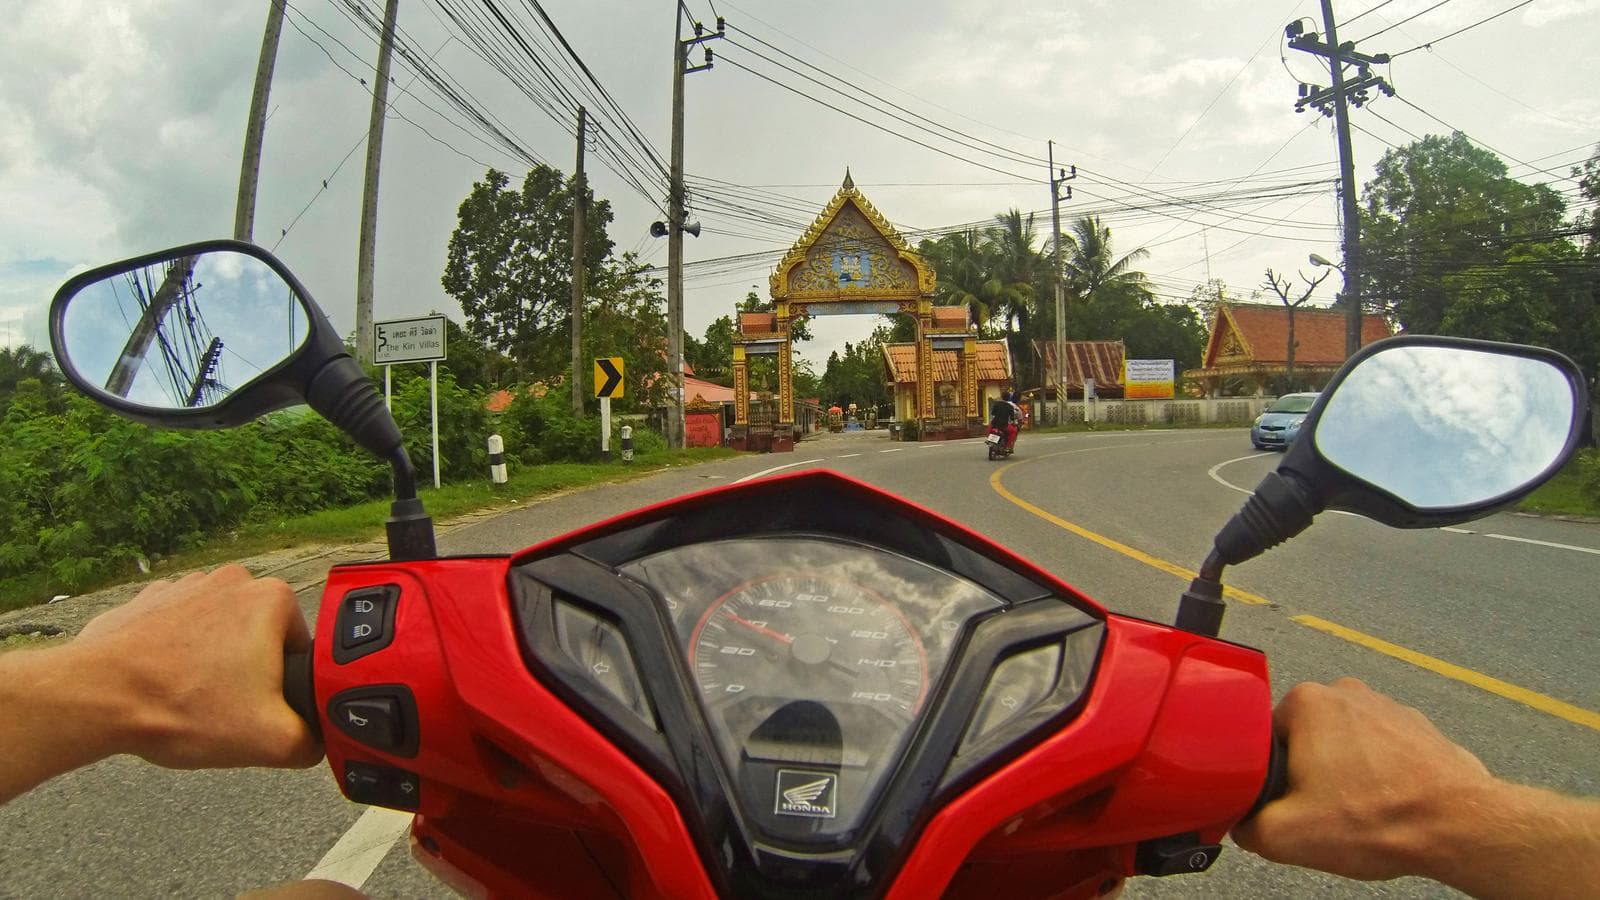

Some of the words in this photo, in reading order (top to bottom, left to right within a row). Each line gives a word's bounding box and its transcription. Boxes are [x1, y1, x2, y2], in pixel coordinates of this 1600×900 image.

[419, 340, 440, 348] Villas
[795, 594, 828, 603] 80
[758, 599, 793, 609] 60
[827, 605, 865, 615] 100
[850, 630, 888, 640] 120
[720, 646, 755, 656] 20
[857, 658, 897, 668] 140
[725, 684, 745, 693] 0
[782, 803, 831, 814] HONDA
